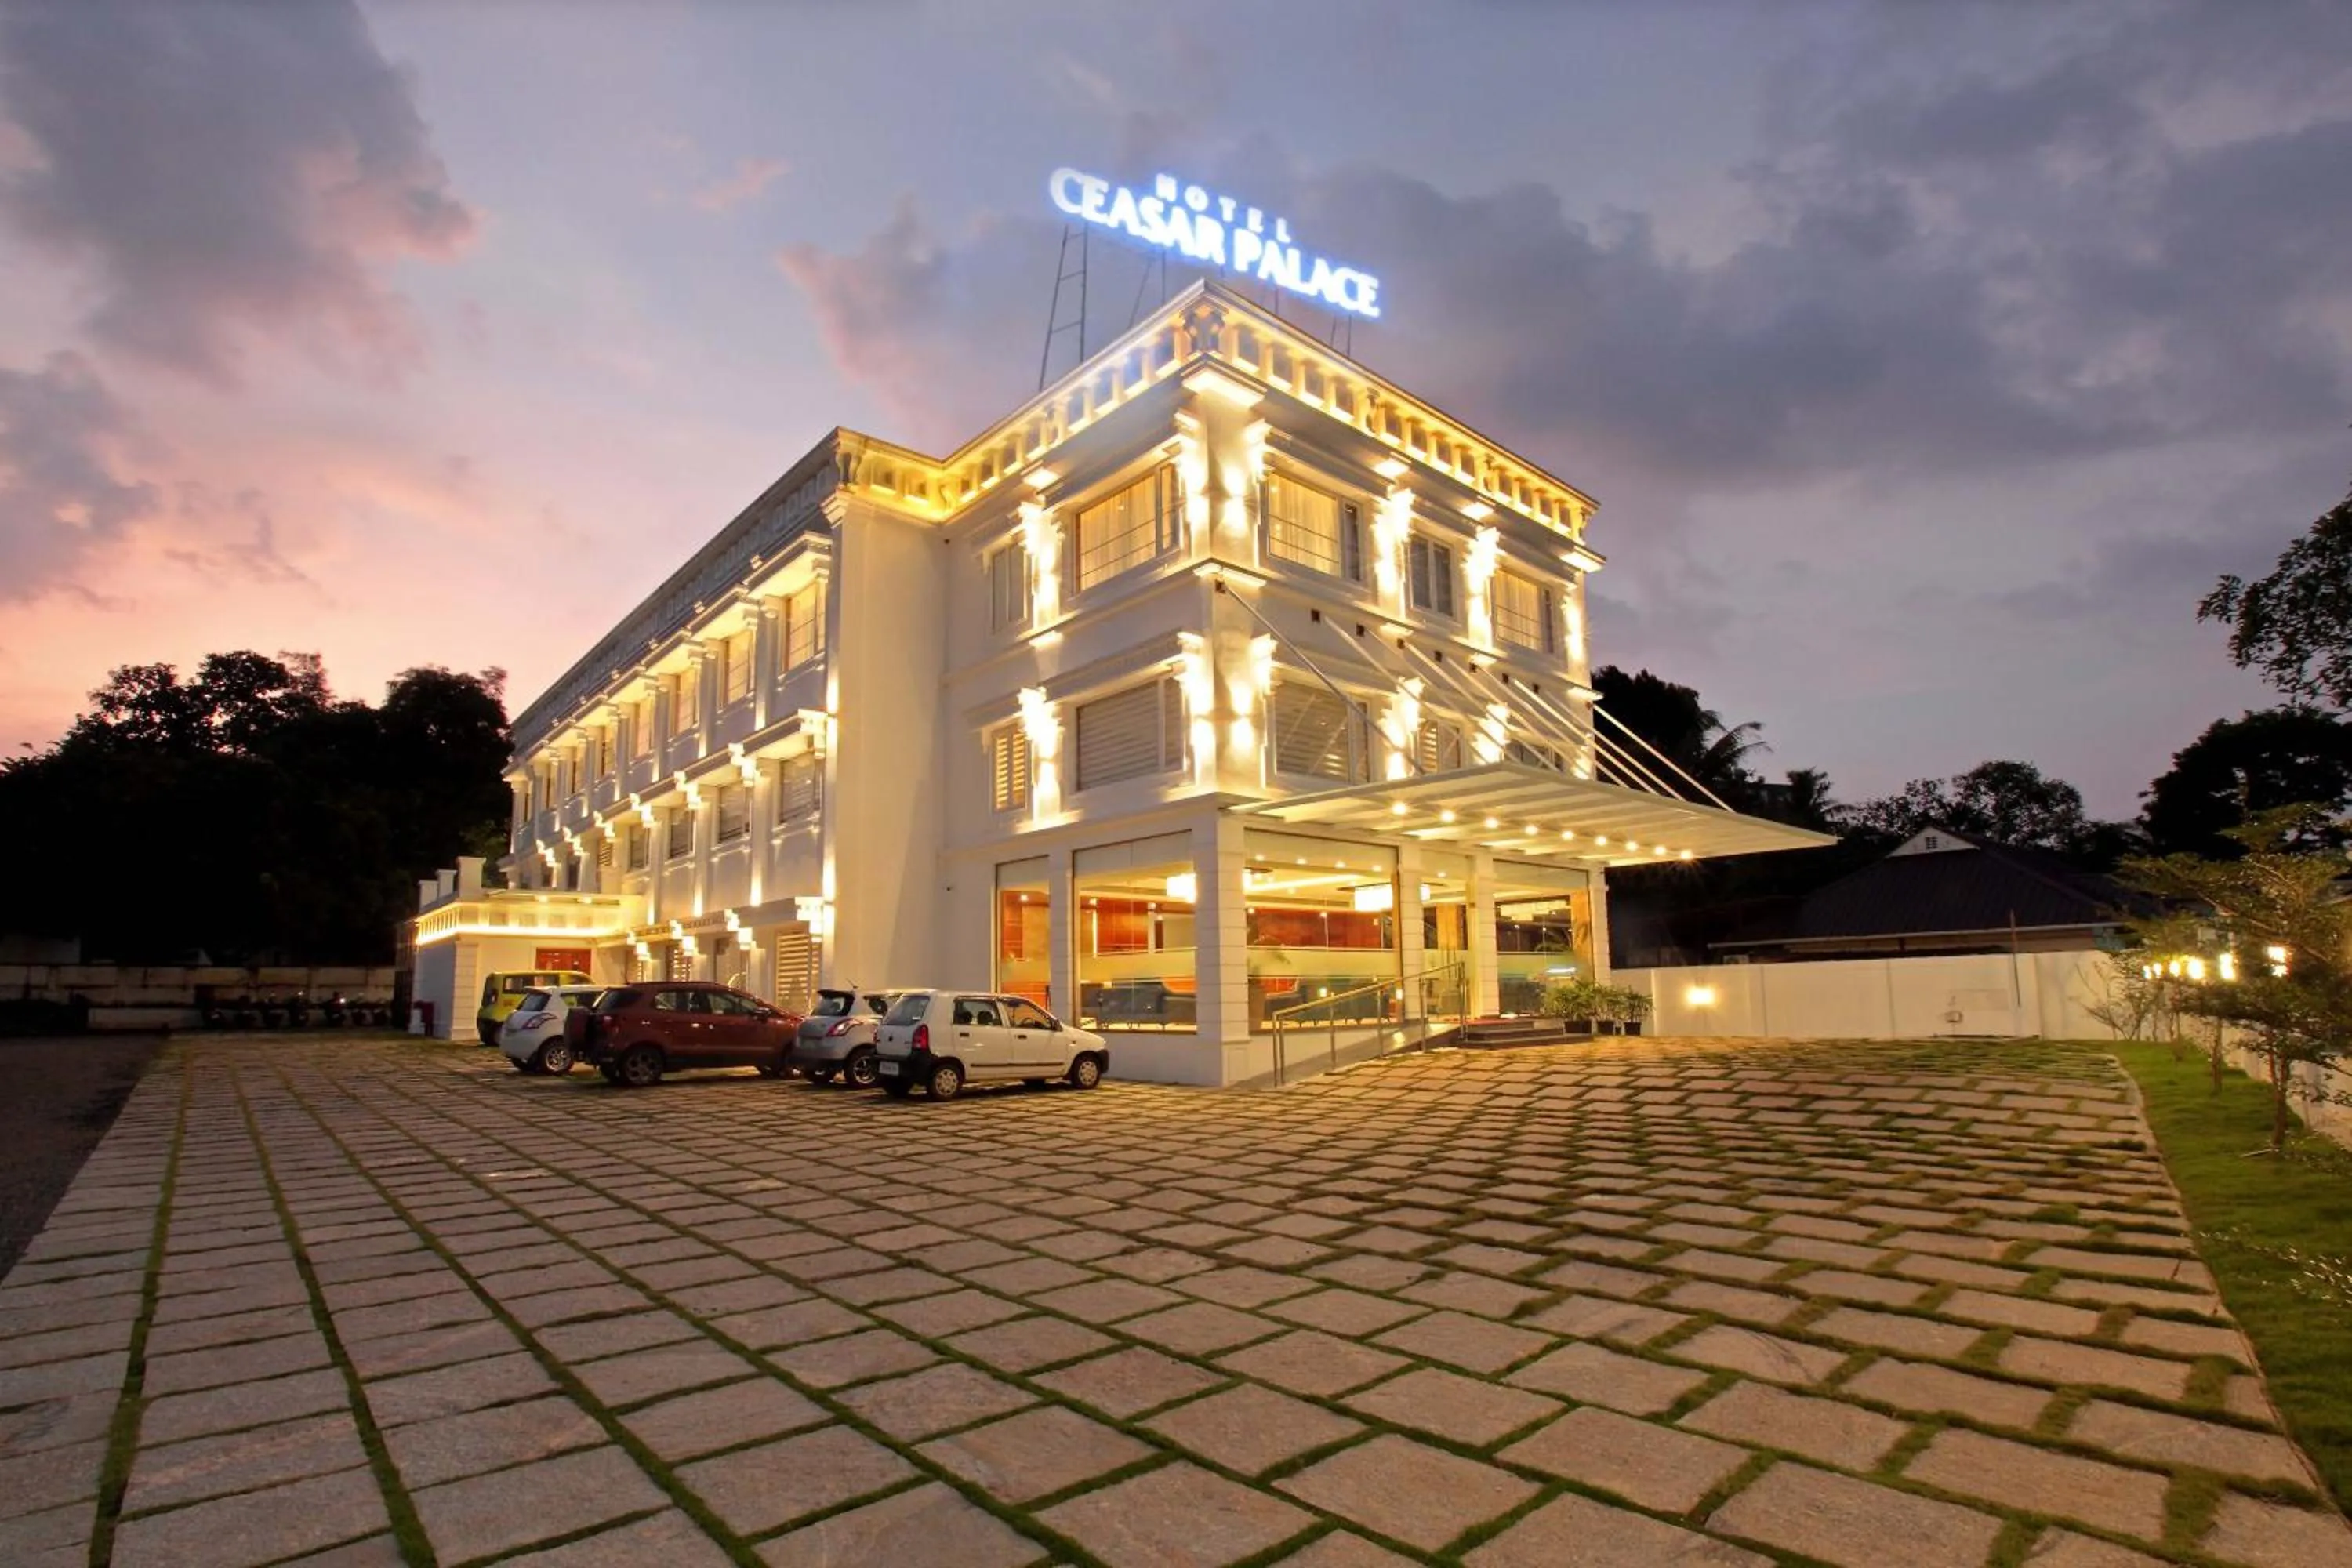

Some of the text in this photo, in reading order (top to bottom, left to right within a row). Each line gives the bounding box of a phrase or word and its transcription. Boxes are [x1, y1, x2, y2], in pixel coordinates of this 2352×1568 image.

[1050, 167, 1381, 318] CEASAR PALACE
[1156, 173, 1291, 243] HOTEL
